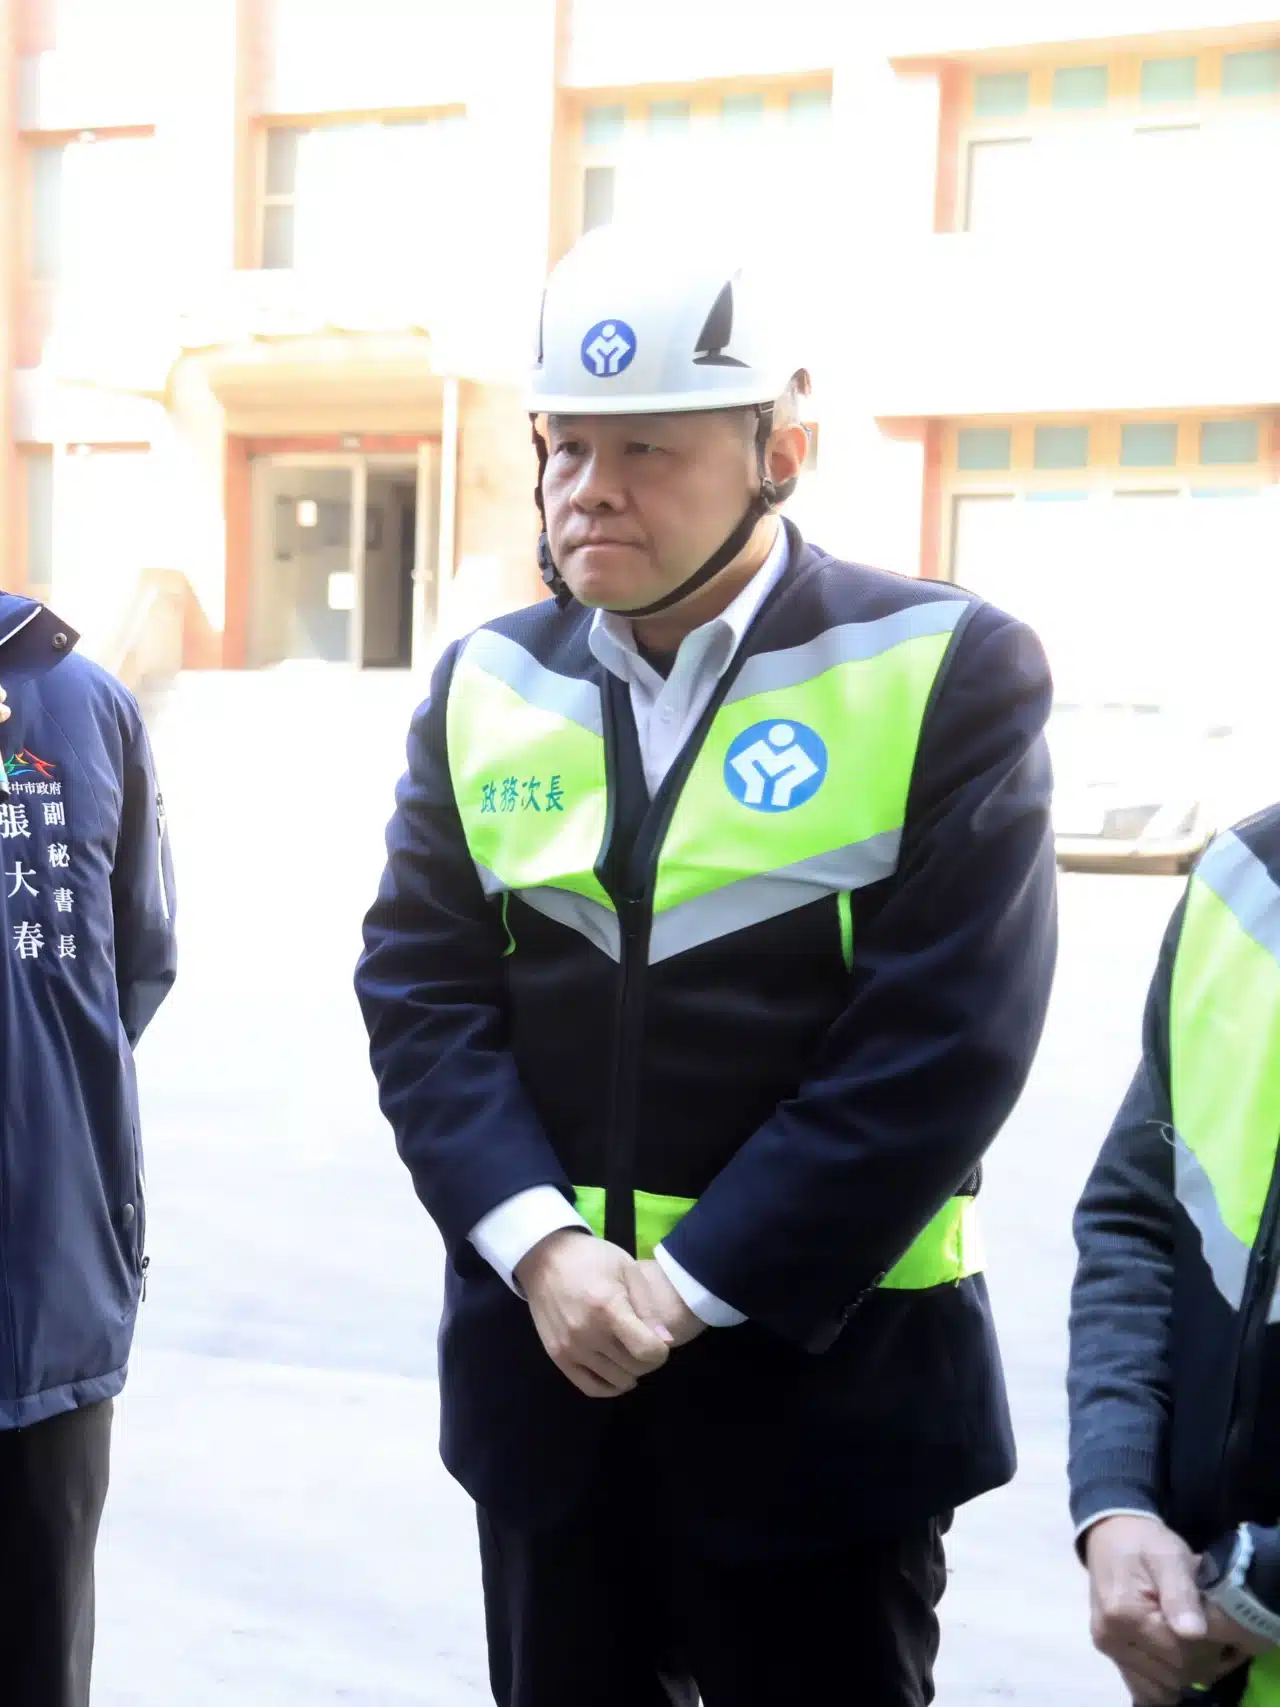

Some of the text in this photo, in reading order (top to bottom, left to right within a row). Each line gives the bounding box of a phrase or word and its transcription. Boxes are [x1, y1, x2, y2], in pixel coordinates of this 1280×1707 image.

[480, 774, 565, 813] 政務次長
[41, 801, 77, 959] 副秘書長
